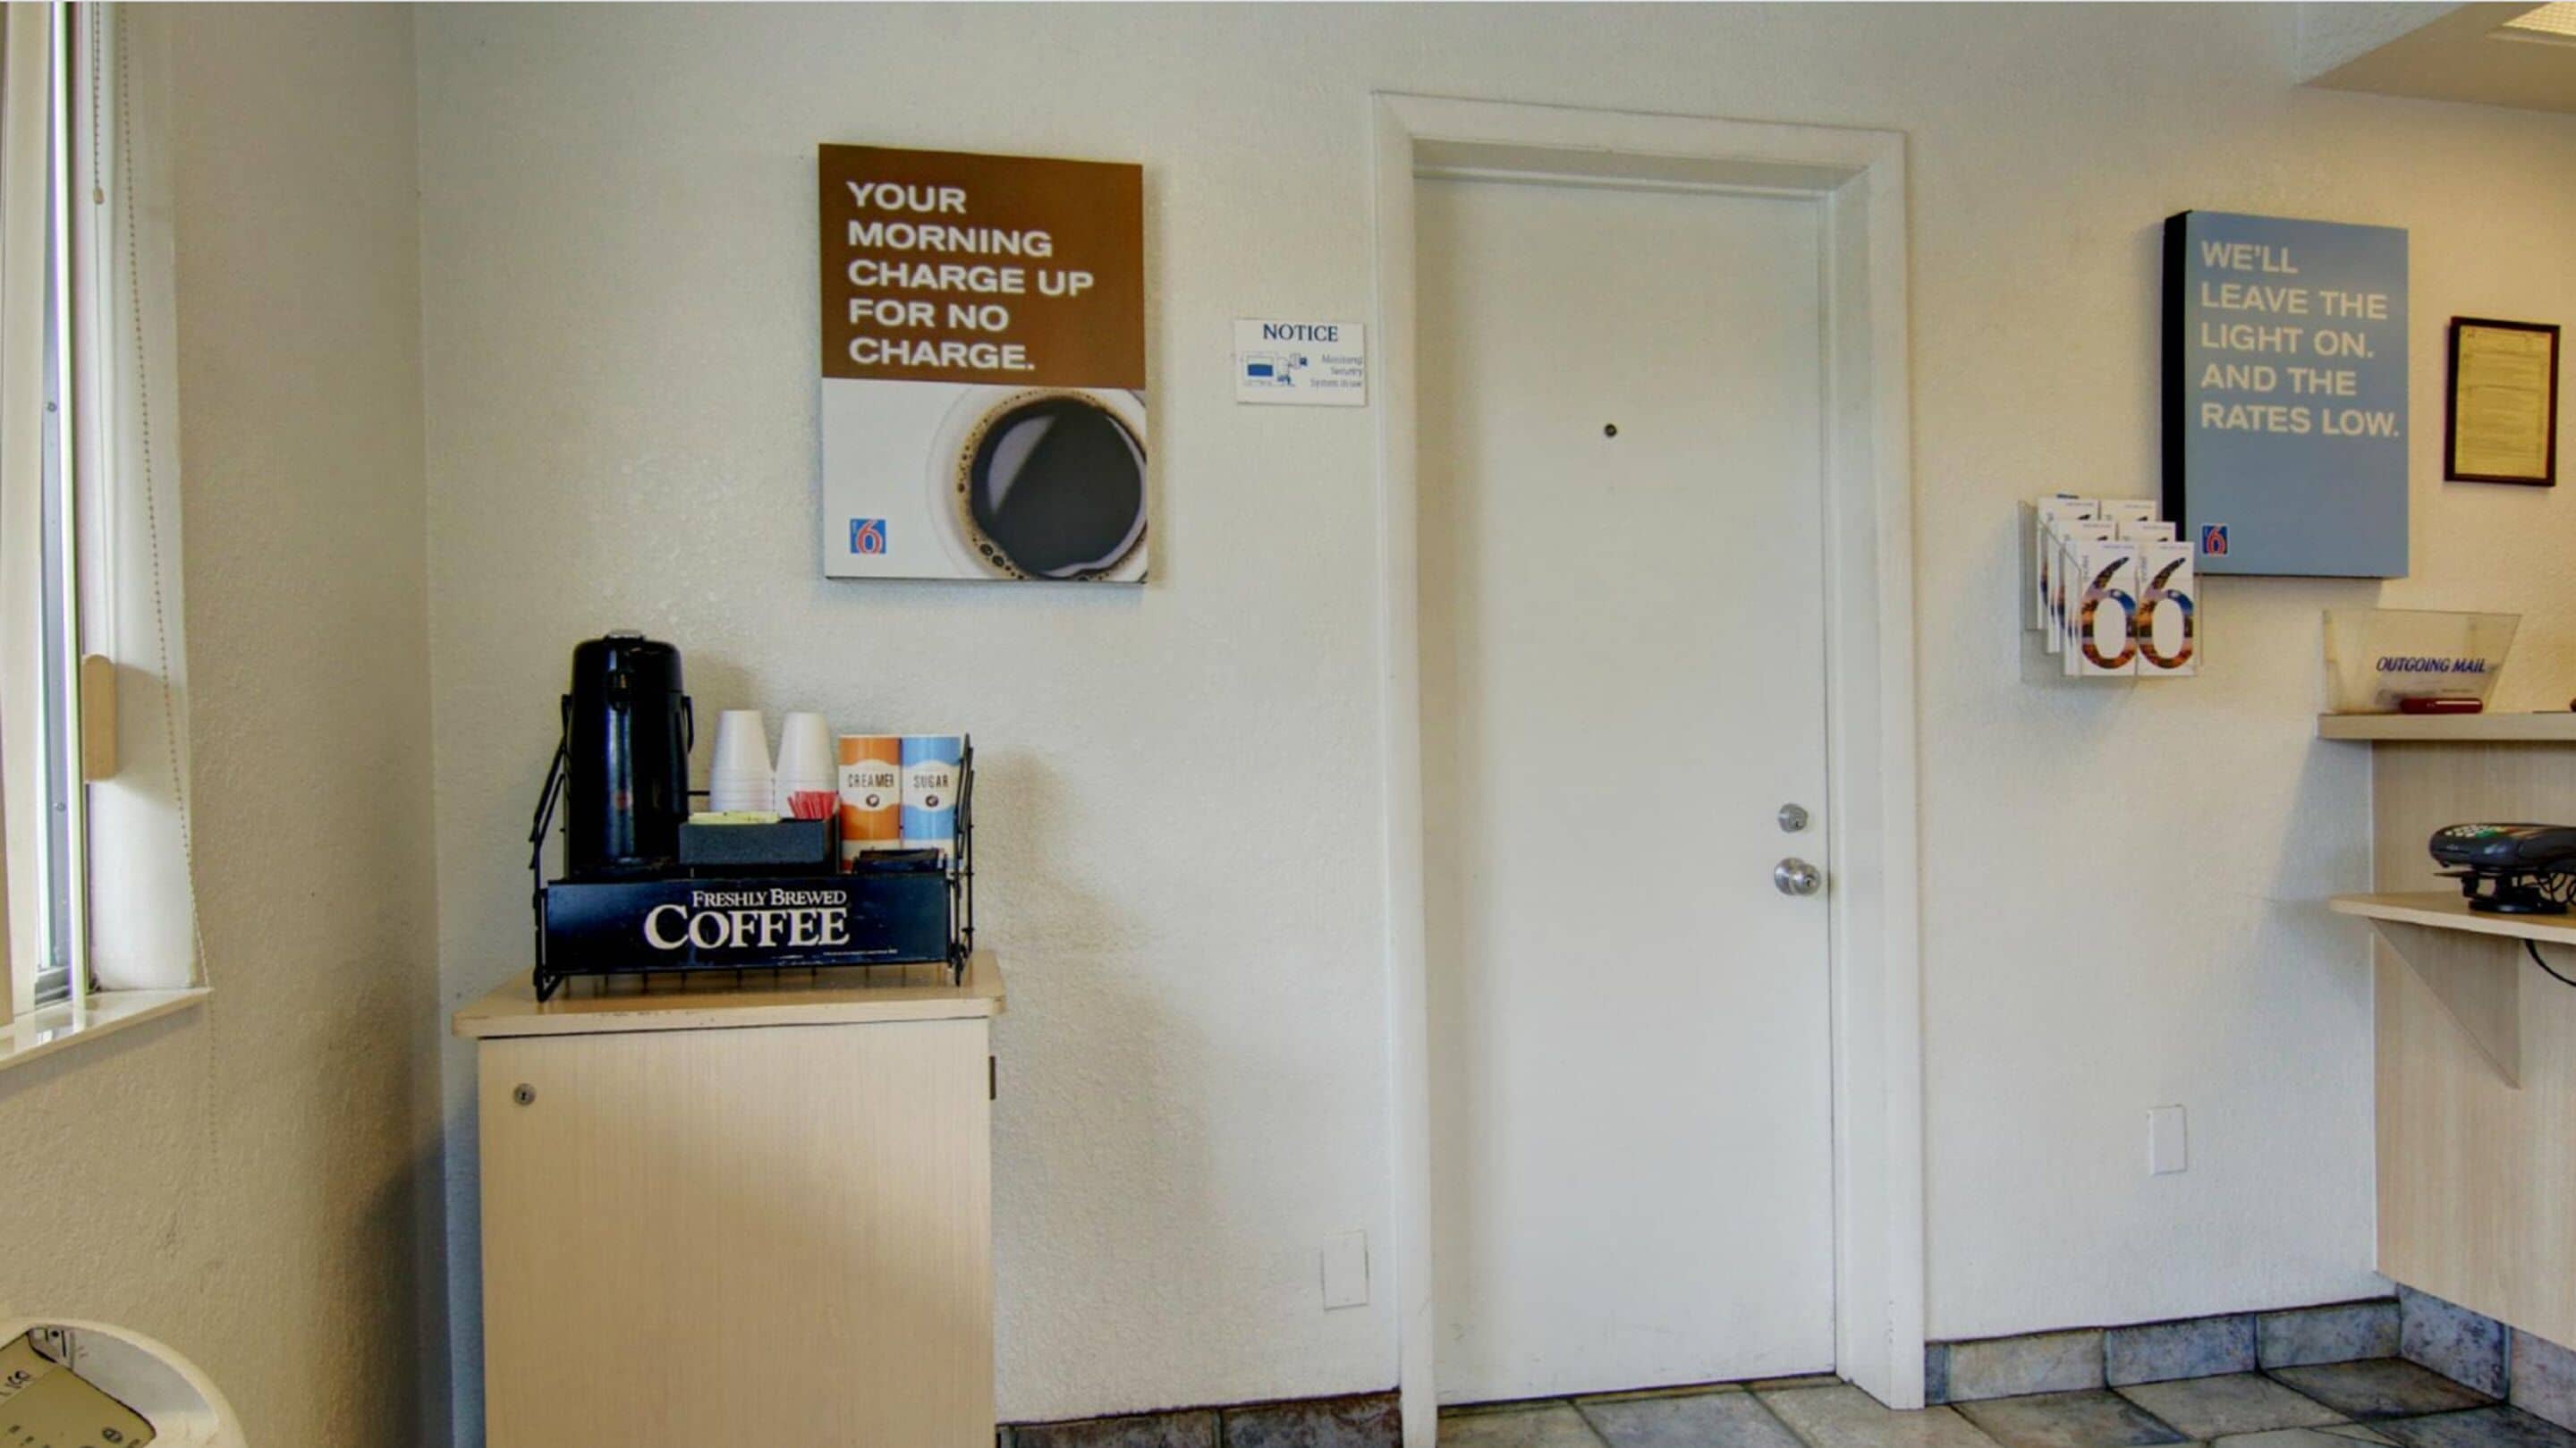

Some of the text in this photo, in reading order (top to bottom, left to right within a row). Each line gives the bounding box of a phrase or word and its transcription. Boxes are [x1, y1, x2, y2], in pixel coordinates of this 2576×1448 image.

[847, 181, 967, 214] YOUR
[847, 220, 1053, 258] MORNING
[2200, 241, 2299, 274] WE'LL
[848, 259, 1095, 297] CHARGE UP
[848, 298, 1010, 333] FOR NO
[2200, 282, 2389, 320] LEAVE THE
[1263, 324, 1339, 343] NOTICE
[2200, 322, 2375, 359] LIGHT ON.
[848, 336, 1036, 371] CHARGE.
[2200, 364, 2358, 396] AND THE
[2200, 402, 2400, 438] RATES LOW.
[856, 519, 883, 555] 6
[2206, 523, 2227, 556] 6
[2080, 556, 2137, 669] 6
[2137, 557, 2194, 669] 6
[2376, 656, 2486, 673] OUTGOING MAIL
[913, 775, 949, 788] SUGAR
[692, 887, 847, 908] FRESHLY BREWED
[644, 903, 850, 950] COFFEE
